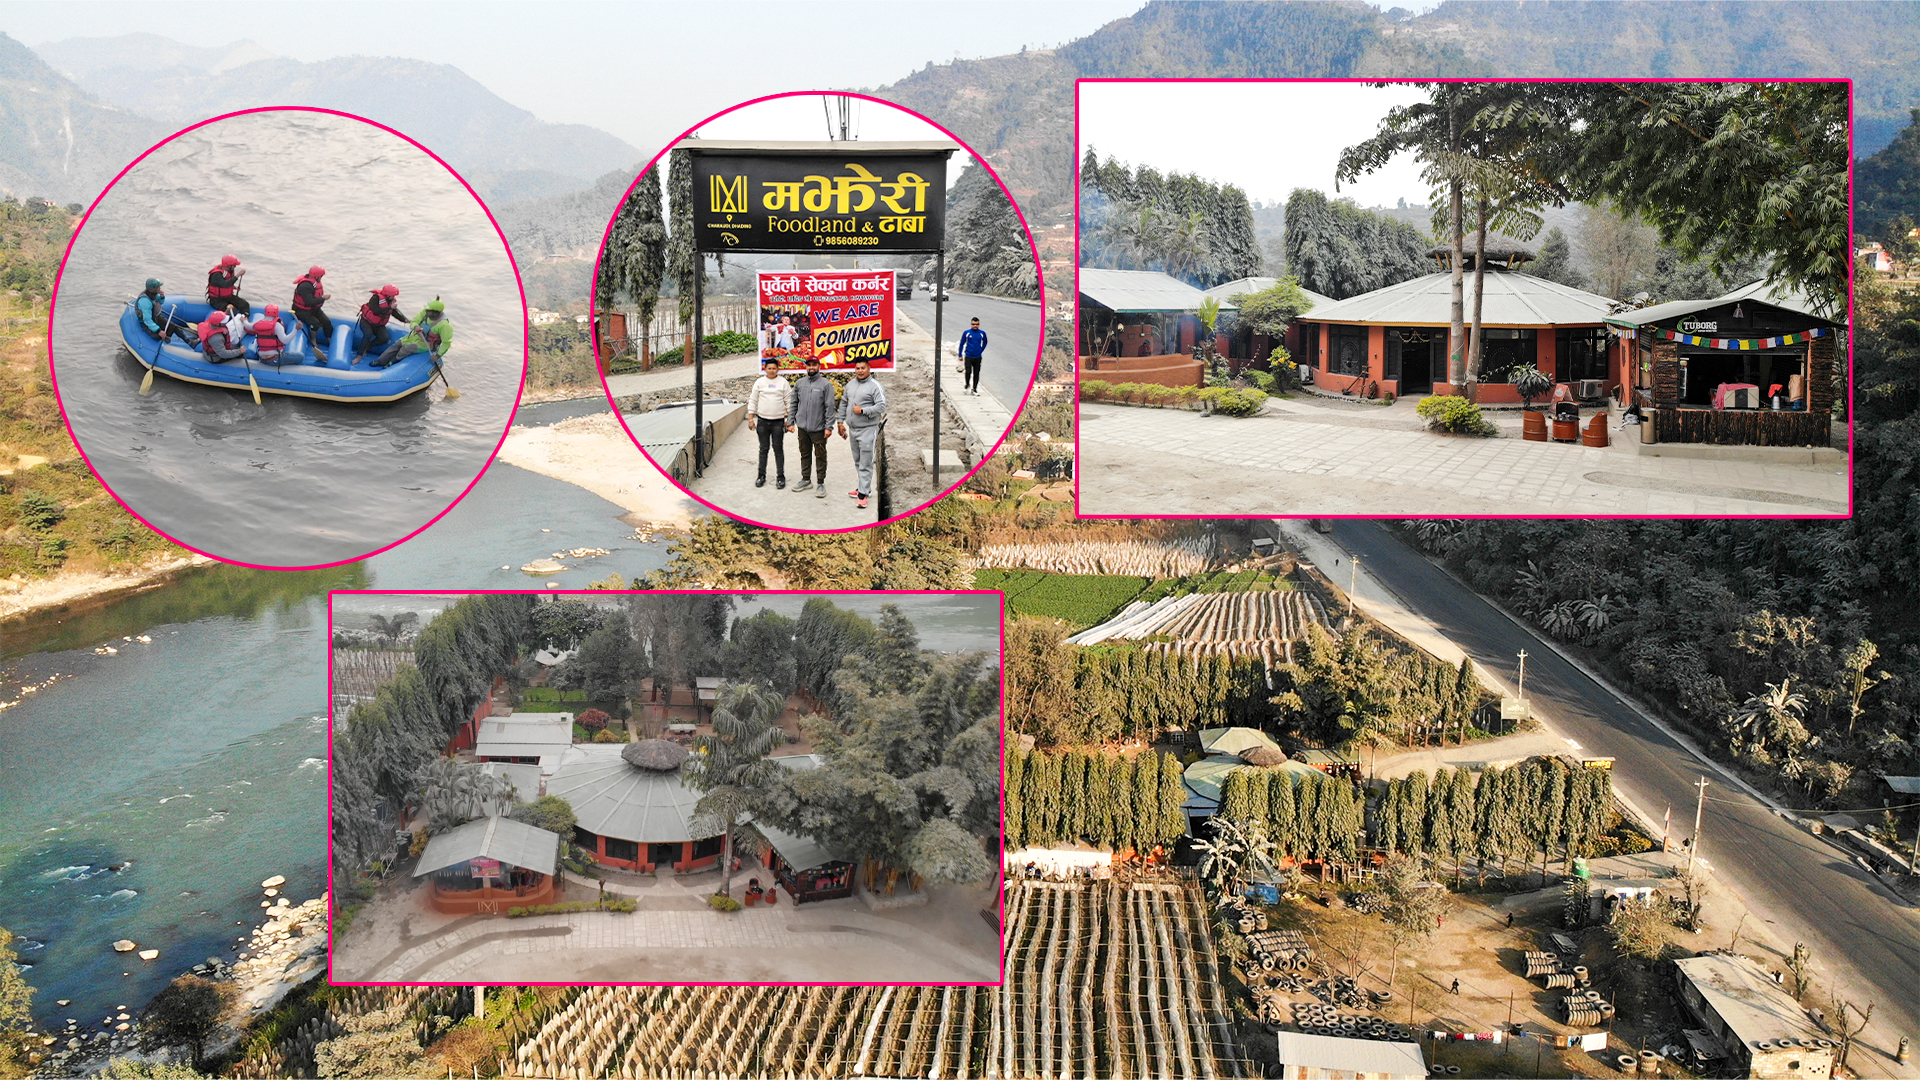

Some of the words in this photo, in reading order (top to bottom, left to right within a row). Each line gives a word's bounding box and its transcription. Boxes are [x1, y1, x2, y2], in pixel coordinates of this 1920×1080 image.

[762, 163, 931, 214] मझेरी
[768, 215, 856, 233] Foodland
[861, 221, 874, 233] &
[879, 216, 927, 233] ढाबा
[825, 236, 879, 246] 9856089230
[852, 275, 891, 291] कर्नर
[814, 308, 841, 324] WE
[844, 302, 880, 321] ARE
[1683, 321, 1718, 330] TUBORG
[815, 323, 881, 348] COMING
[845, 341, 889, 362] SOON
